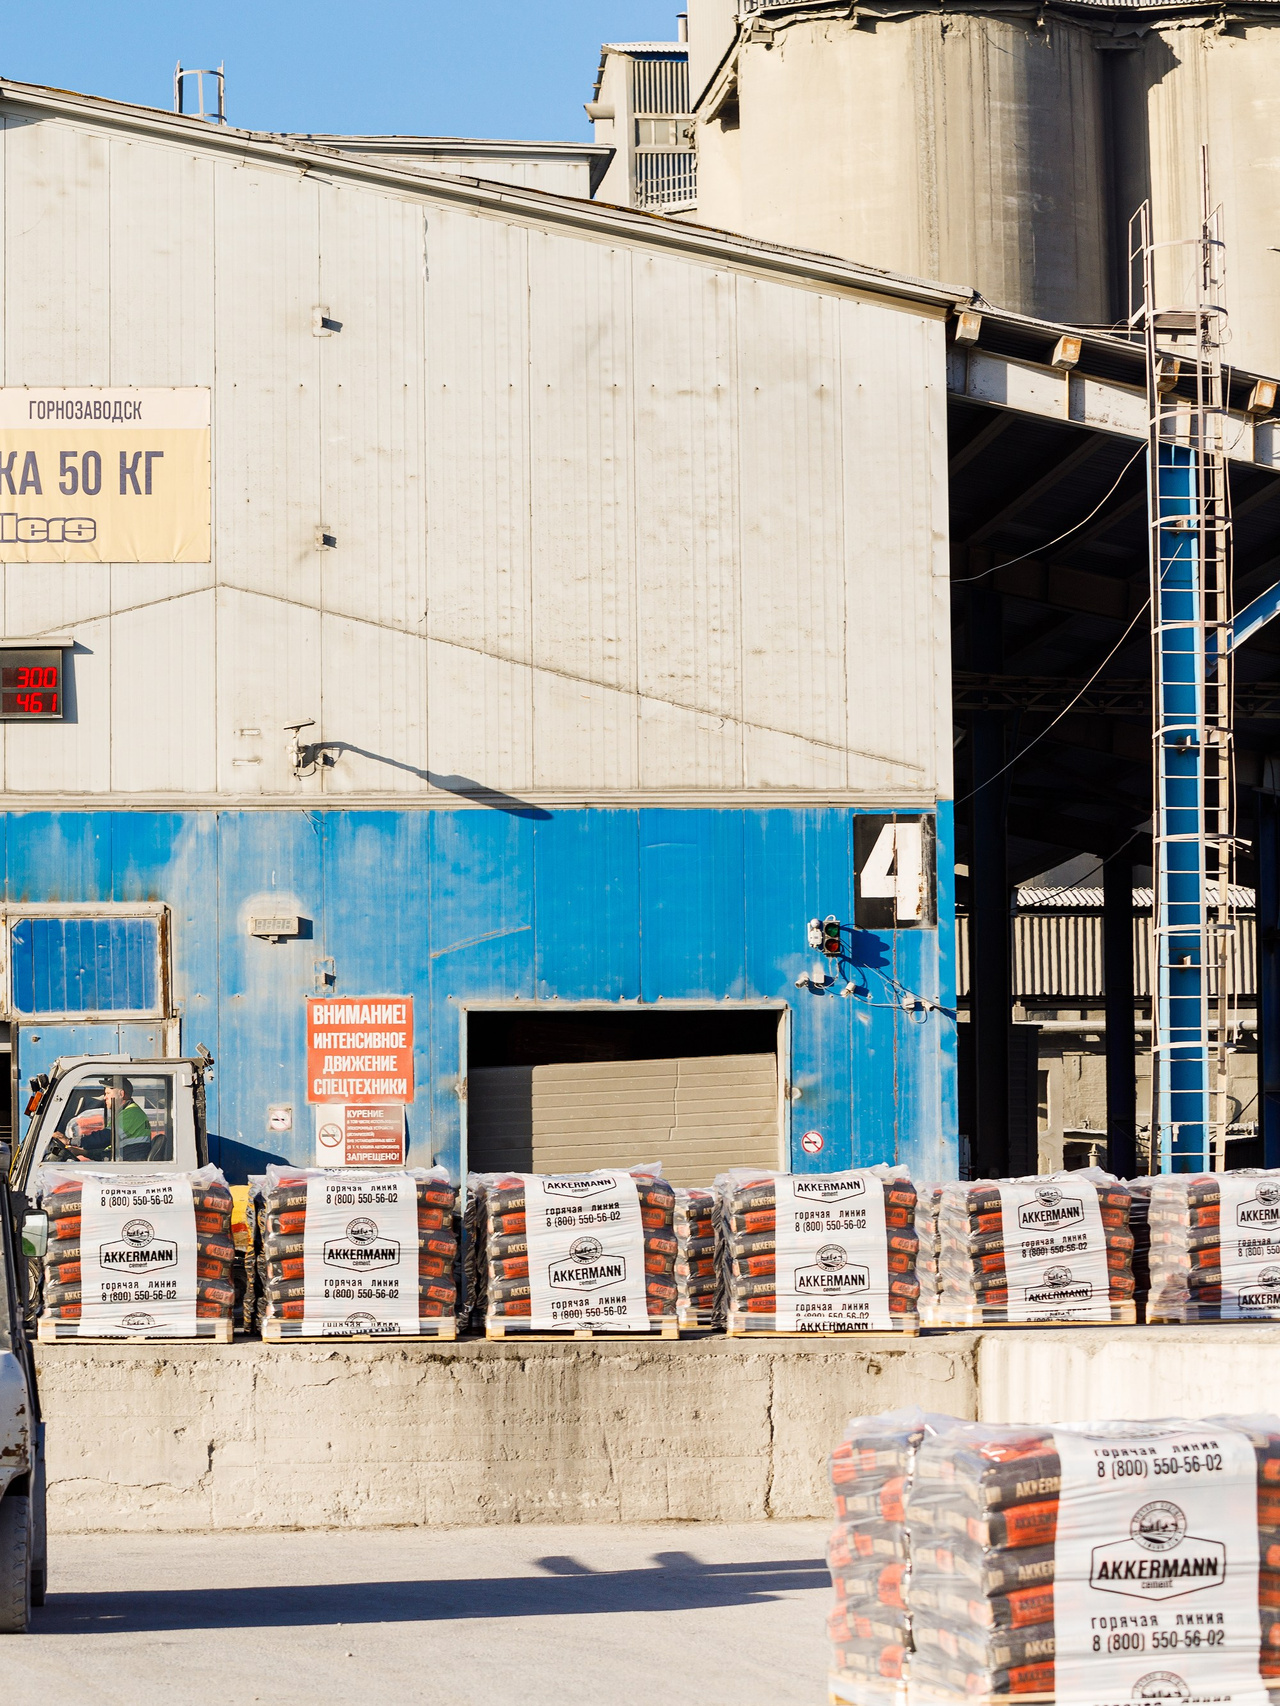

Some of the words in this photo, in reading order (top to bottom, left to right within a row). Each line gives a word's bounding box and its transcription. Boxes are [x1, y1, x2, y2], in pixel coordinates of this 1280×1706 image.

[29, 400, 142, 423] ГОРНОЗАВОДСК
[59, 451, 102, 496] 50
[120, 451, 164, 496] КГ
[17, 667, 58, 688] 300
[16, 692, 58, 713] 461
[860, 822, 927, 921] 4
[313, 1004, 407, 1024] ВНИМАНИЕ!
[313, 1032, 407, 1049] ИНТЕНСИВНОЕ
[322, 1055, 398, 1075] ДВИЖЕНИЕ
[313, 1078, 408, 1098] СПЕЦТЕХНИКИ
[346, 1109, 384, 1118] КУРЕНИЕ
[346, 1152, 400, 1161] ЗАПРЕЩЕНО!
[100, 1188, 137, 1196] горячая
[145, 1186, 173, 1194] линия
[326, 1185, 362, 1193] горячая
[371, 1183, 398, 1192] линия
[547, 1179, 612, 1189] AKKERMANN
[796, 1180, 861, 1192] AKKERMANN
[100, 1196, 106, 1207] 8
[108, 1195, 130, 1208] (800)
[132, 1194, 174, 1206] 550-56-02
[326, 1194, 331, 1204] 8
[334, 1193, 356, 1206] (800)
[358, 1193, 398, 1204] 550-56-02
[545, 1206, 583, 1215] горячая
[591, 1202, 620, 1212] линия
[794, 1210, 831, 1221] горячая
[839, 1208, 866, 1218] линия
[1021, 1206, 1080, 1224] AKKERMANN
[1239, 1208, 1280, 1222] AKKERM
[546, 1217, 551, 1227] 8
[554, 1215, 576, 1228] (800)
[578, 1211, 621, 1225] 550-56-02
[794, 1221, 800, 1232] 8
[803, 1220, 824, 1233] (800)
[826, 1218, 867, 1231] 550-56-02
[103, 1249, 173, 1264] AKKERMANN
[327, 1248, 396, 1260] AKKERMANN
[128, 1261, 148, 1269] cement
[553, 1264, 622, 1283] AKKERMANN
[798, 1274, 866, 1287] AKKERMANN
[101, 1281, 139, 1291] горячая
[148, 1280, 177, 1289] линия
[324, 1279, 363, 1289] горячая
[371, 1279, 399, 1287] линия
[101, 1291, 107, 1301] 8
[109, 1290, 131, 1302] (800)
[134, 1290, 177, 1301] 550-56-02
[324, 1289, 330, 1299] 8
[332, 1288, 355, 1300] (800)
[357, 1288, 399, 1299] 550-56-02
[1241, 1294, 1280, 1306] AKKERM
[551, 1298, 590, 1310] горячая
[598, 1295, 627, 1304] линия
[795, 1303, 833, 1313] горячая
[841, 1302, 870, 1311] линия
[552, 1310, 557, 1320] 8
[560, 1308, 583, 1320] (800)
[585, 1305, 627, 1317] 550-56-02
[1094, 1447, 1157, 1459] горячая
[1172, 1440, 1219, 1453] линия
[1097, 1460, 1106, 1478] 8
[1111, 1458, 1148, 1480] (800)
[1153, 1453, 1223, 1475] 550-56-02
[1015, 1476, 1060, 1498] AKKERM
[1018, 1560, 1055, 1579] AKKER
[1096, 1557, 1219, 1580] AKKERMANN
[1141, 1580, 1173, 1589] cement
[1091, 1615, 1159, 1632] горячая
[1175, 1612, 1225, 1625] линия
[1092, 1634, 1101, 1652] 8
[1107, 1632, 1145, 1653] (800)
[1151, 1629, 1225, 1648] 550-56-02
